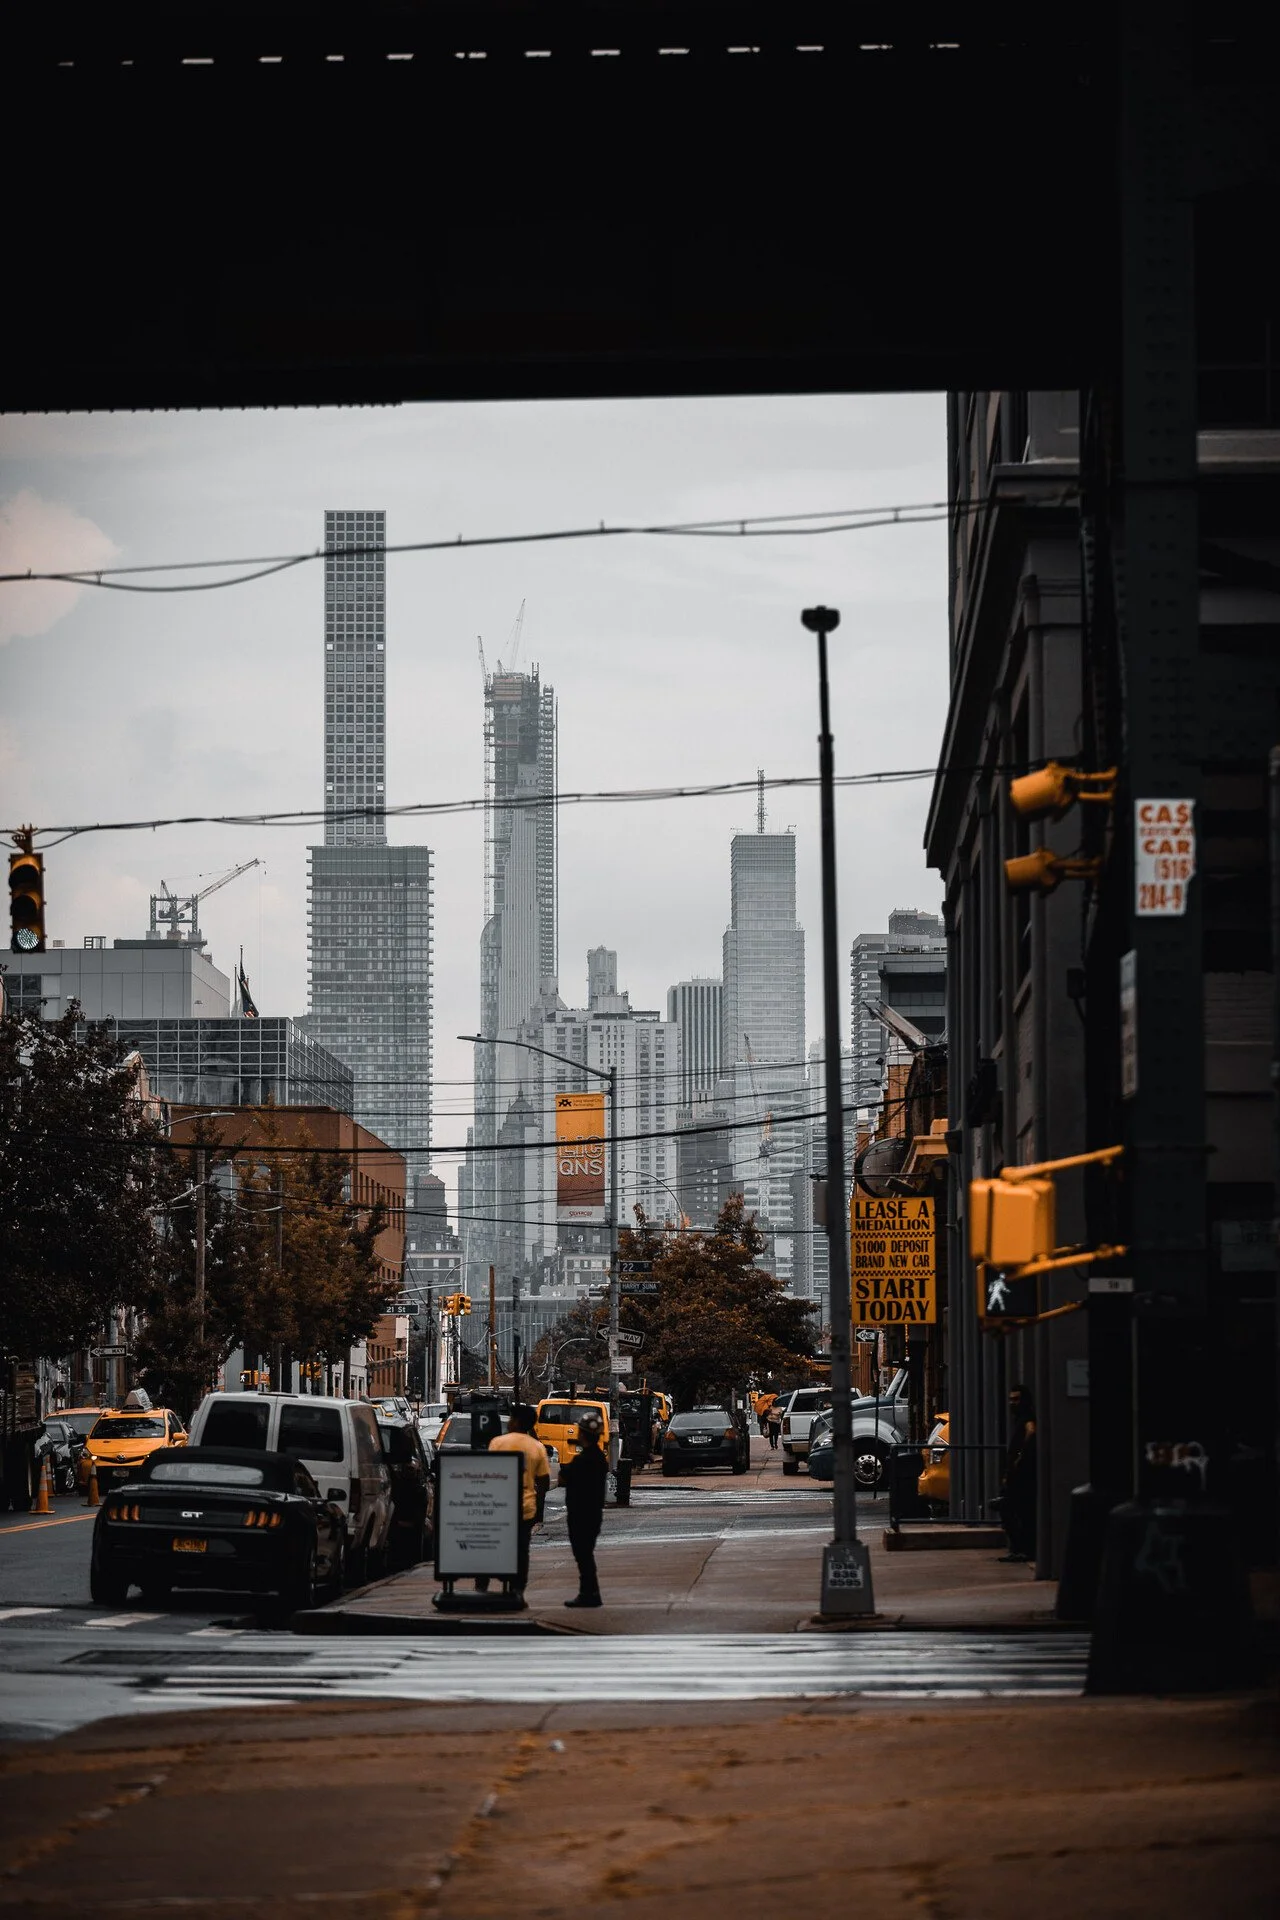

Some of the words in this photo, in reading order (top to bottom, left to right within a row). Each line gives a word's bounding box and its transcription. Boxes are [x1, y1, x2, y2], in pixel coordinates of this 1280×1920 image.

[1143, 840, 1190, 855] CAR
[560, 1160, 602, 1175] QNS
[855, 1201, 908, 1219] LEASE
[918, 1200, 929, 1218] A
[855, 1219, 930, 1231] MEDALLION
[855, 1240, 886, 1253] $1000
[891, 1239, 930, 1253] DEPOSIT
[622, 1263, 634, 1272] 22
[855, 1255, 885, 1268] BRAND
[889, 1255, 908, 1268] NEW
[912, 1254, 930, 1268] CAR
[855, 1278, 930, 1299] START
[856, 1300, 930, 1321] TODAY
[624, 1333, 639, 1342] WAY
[479, 1415, 489, 1430] P
